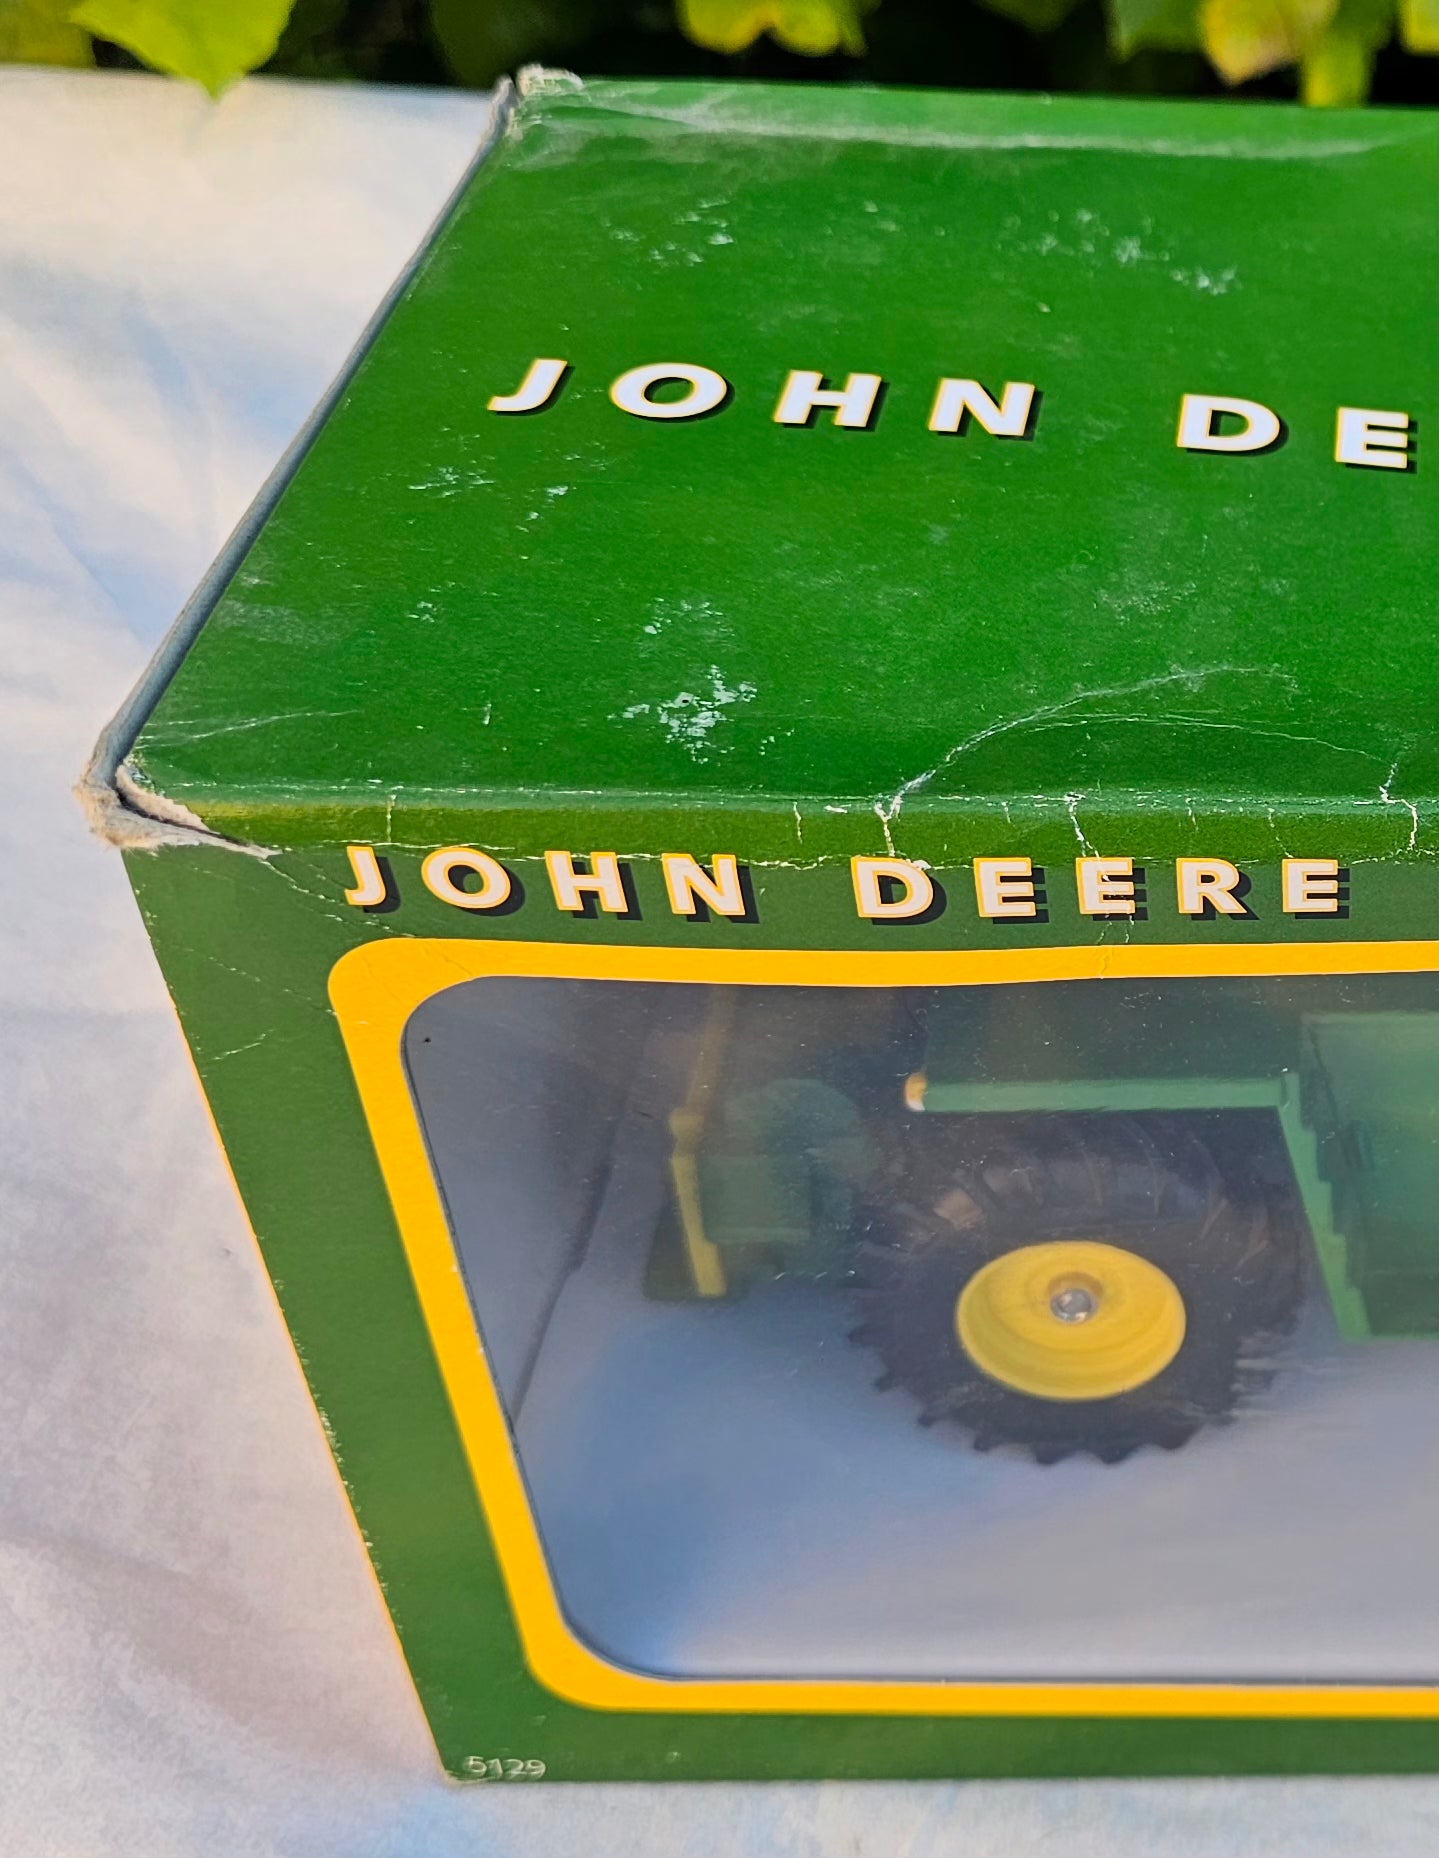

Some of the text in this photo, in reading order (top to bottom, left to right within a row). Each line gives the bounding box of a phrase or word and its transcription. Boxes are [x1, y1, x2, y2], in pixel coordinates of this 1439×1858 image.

[486, 357, 1041, 439] JOHN
[344, 845, 756, 922] JOHN
[850, 856, 1346, 922] DEERE
[464, 1755, 547, 1781] 5129
